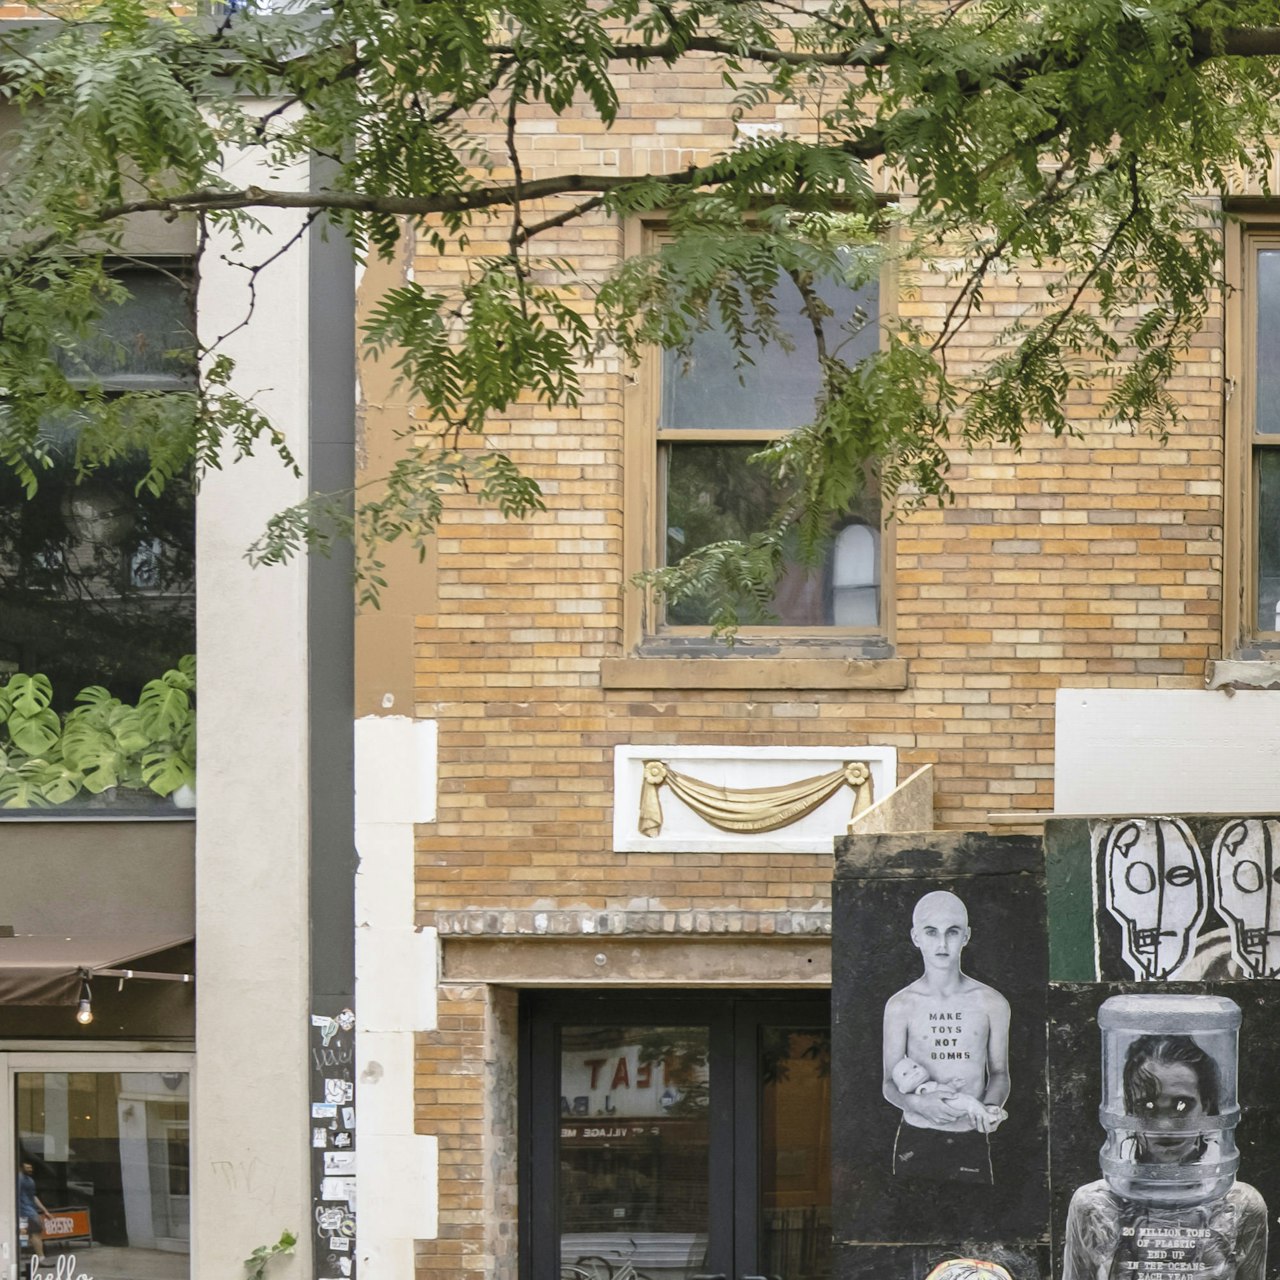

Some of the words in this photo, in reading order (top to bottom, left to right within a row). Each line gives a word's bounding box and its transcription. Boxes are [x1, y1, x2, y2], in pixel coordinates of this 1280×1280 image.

[929, 1012, 962, 1021] MAKE
[931, 1026, 962, 1034] TOYS
[935, 1038, 958, 1047] NOT
[931, 1052, 971, 1060] BOMBS
[1122, 1227, 1135, 1236] 20
[1139, 1228, 1182, 1237] MILLION
[1186, 1228, 1211, 1238] TONS
[1137, 1240, 1149, 1248] OF
[1155, 1240, 1196, 1249] PLASTIC
[1147, 1250, 1168, 1259] END
[1172, 1251, 1186, 1259] UP
[1127, 1261, 1139, 1270] IN
[1145, 1261, 1164, 1270] THE
[1168, 1262, 1206, 1271] OCEANS
[1137, 1272, 1163, 1280] EACH
